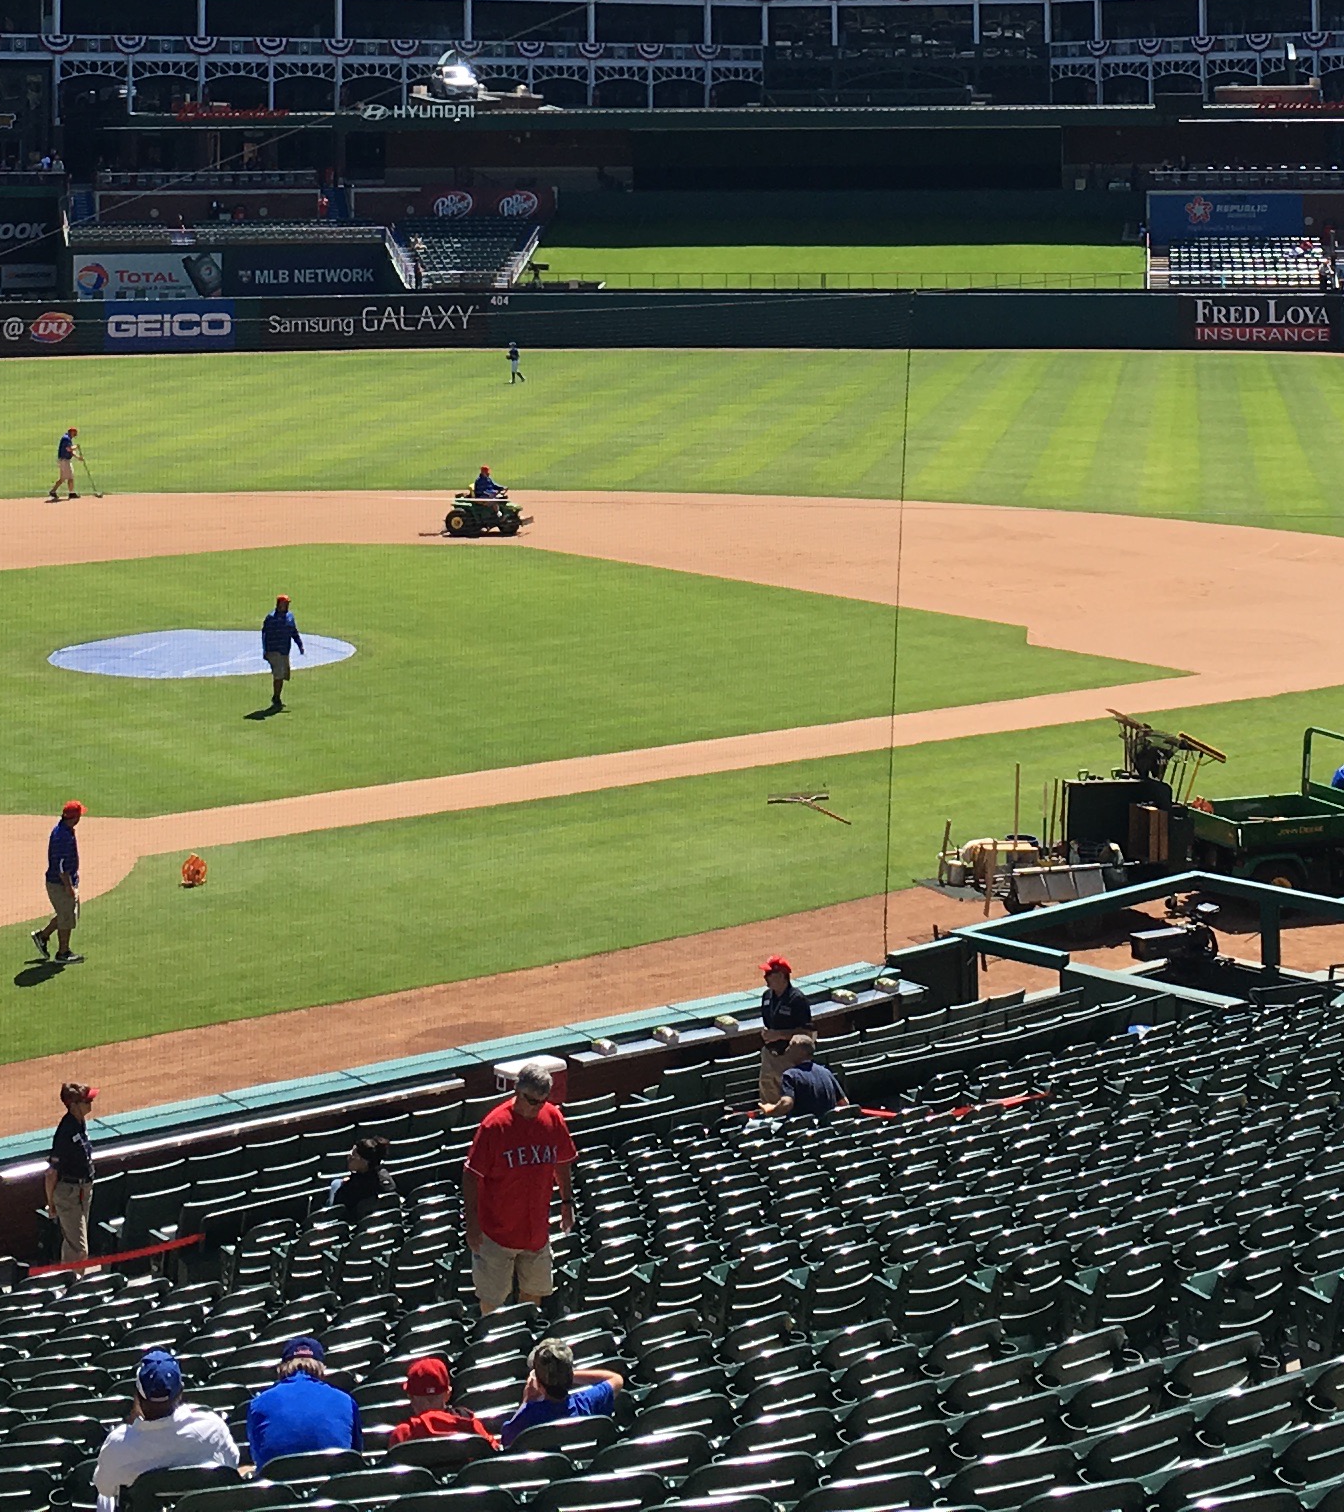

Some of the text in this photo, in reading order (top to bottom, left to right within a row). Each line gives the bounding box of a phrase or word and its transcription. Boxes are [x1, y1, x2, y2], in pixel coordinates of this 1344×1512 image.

[393, 104, 476, 119] HYUNDAI
[1215, 203, 1268, 214] REPUBLIC
[115, 269, 180, 284] TOTAL
[255, 268, 375, 284] MLB NETWORK
[490, 294, 509, 305] 404
[268, 304, 475, 336] Samsung GALAXY
[1195, 299, 1331, 325] FRED LOYA
[107, 312, 232, 338] GEICO
[1196, 327, 1331, 343] INSURANCE
